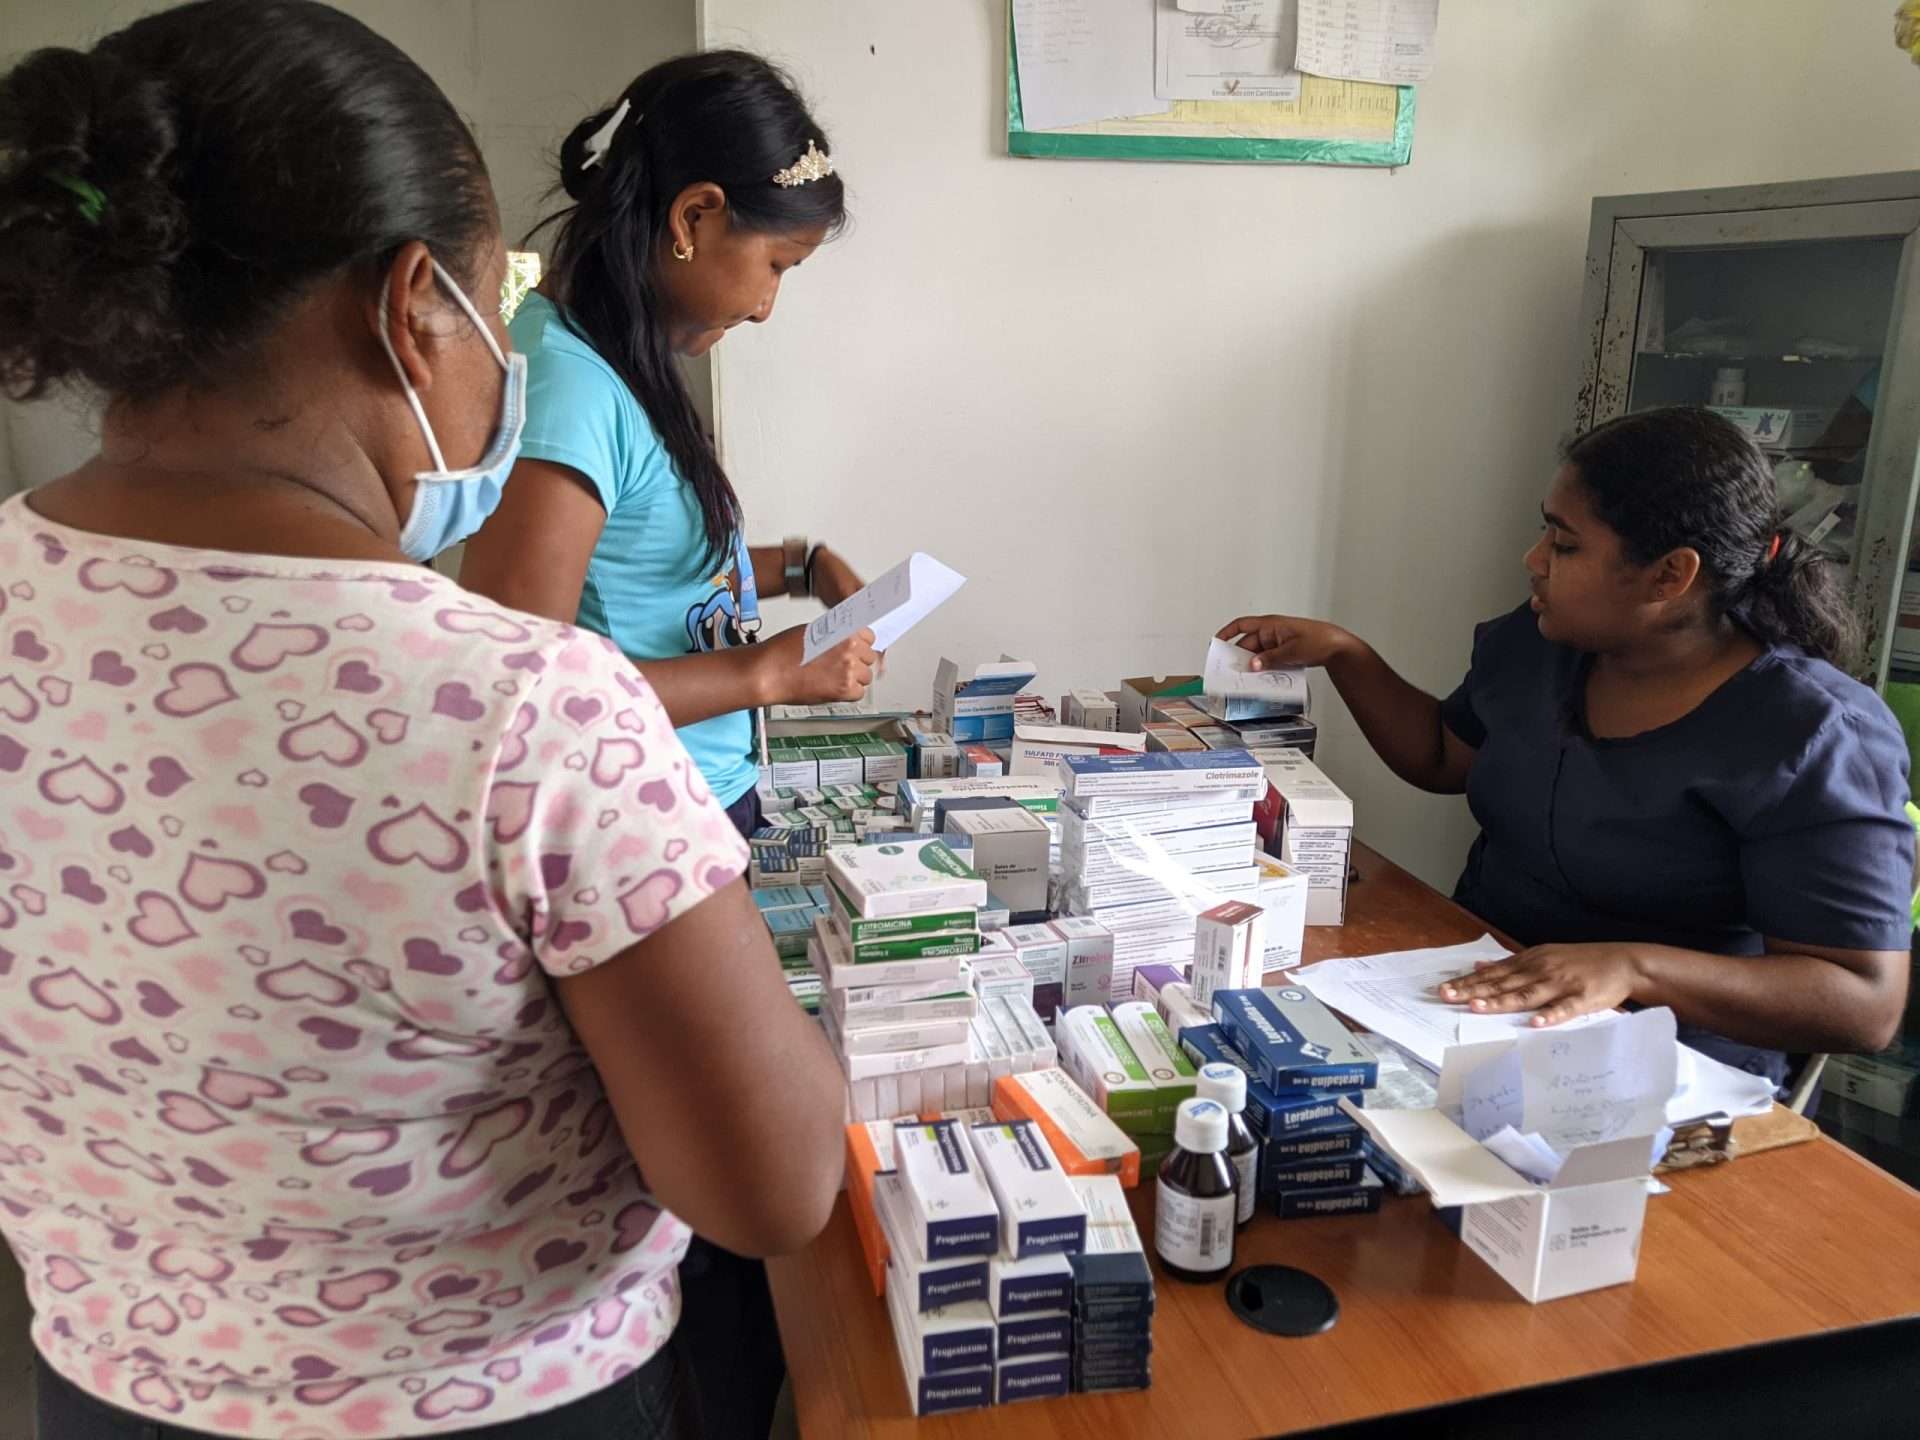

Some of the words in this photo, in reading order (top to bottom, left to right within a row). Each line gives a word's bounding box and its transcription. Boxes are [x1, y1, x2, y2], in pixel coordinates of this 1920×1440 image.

[1205, 769, 1259, 780] Clotrimazole
[857, 919, 913, 931] AZITROMICINA
[921, 944, 974, 957] AZITROMICINA
[1311, 1073, 1366, 1088] Loratadina
[1284, 1105, 1335, 1124] Loratadina
[1297, 1137, 1351, 1154] Loratadina
[1295, 1168, 1351, 1184] Loratadina
[1314, 1197, 1368, 1213] Loratadina
[935, 1231, 991, 1245] Progesterona
[1025, 1231, 1079, 1245] Progesterona
[927, 1278, 982, 1295] Progesterona
[1008, 1287, 1063, 1301] Progesterona
[1007, 1331, 1062, 1345] Progesterona
[931, 1343, 988, 1358] Progesterona
[1007, 1373, 1062, 1387] Progesterona
[926, 1385, 982, 1400] Progesterona
